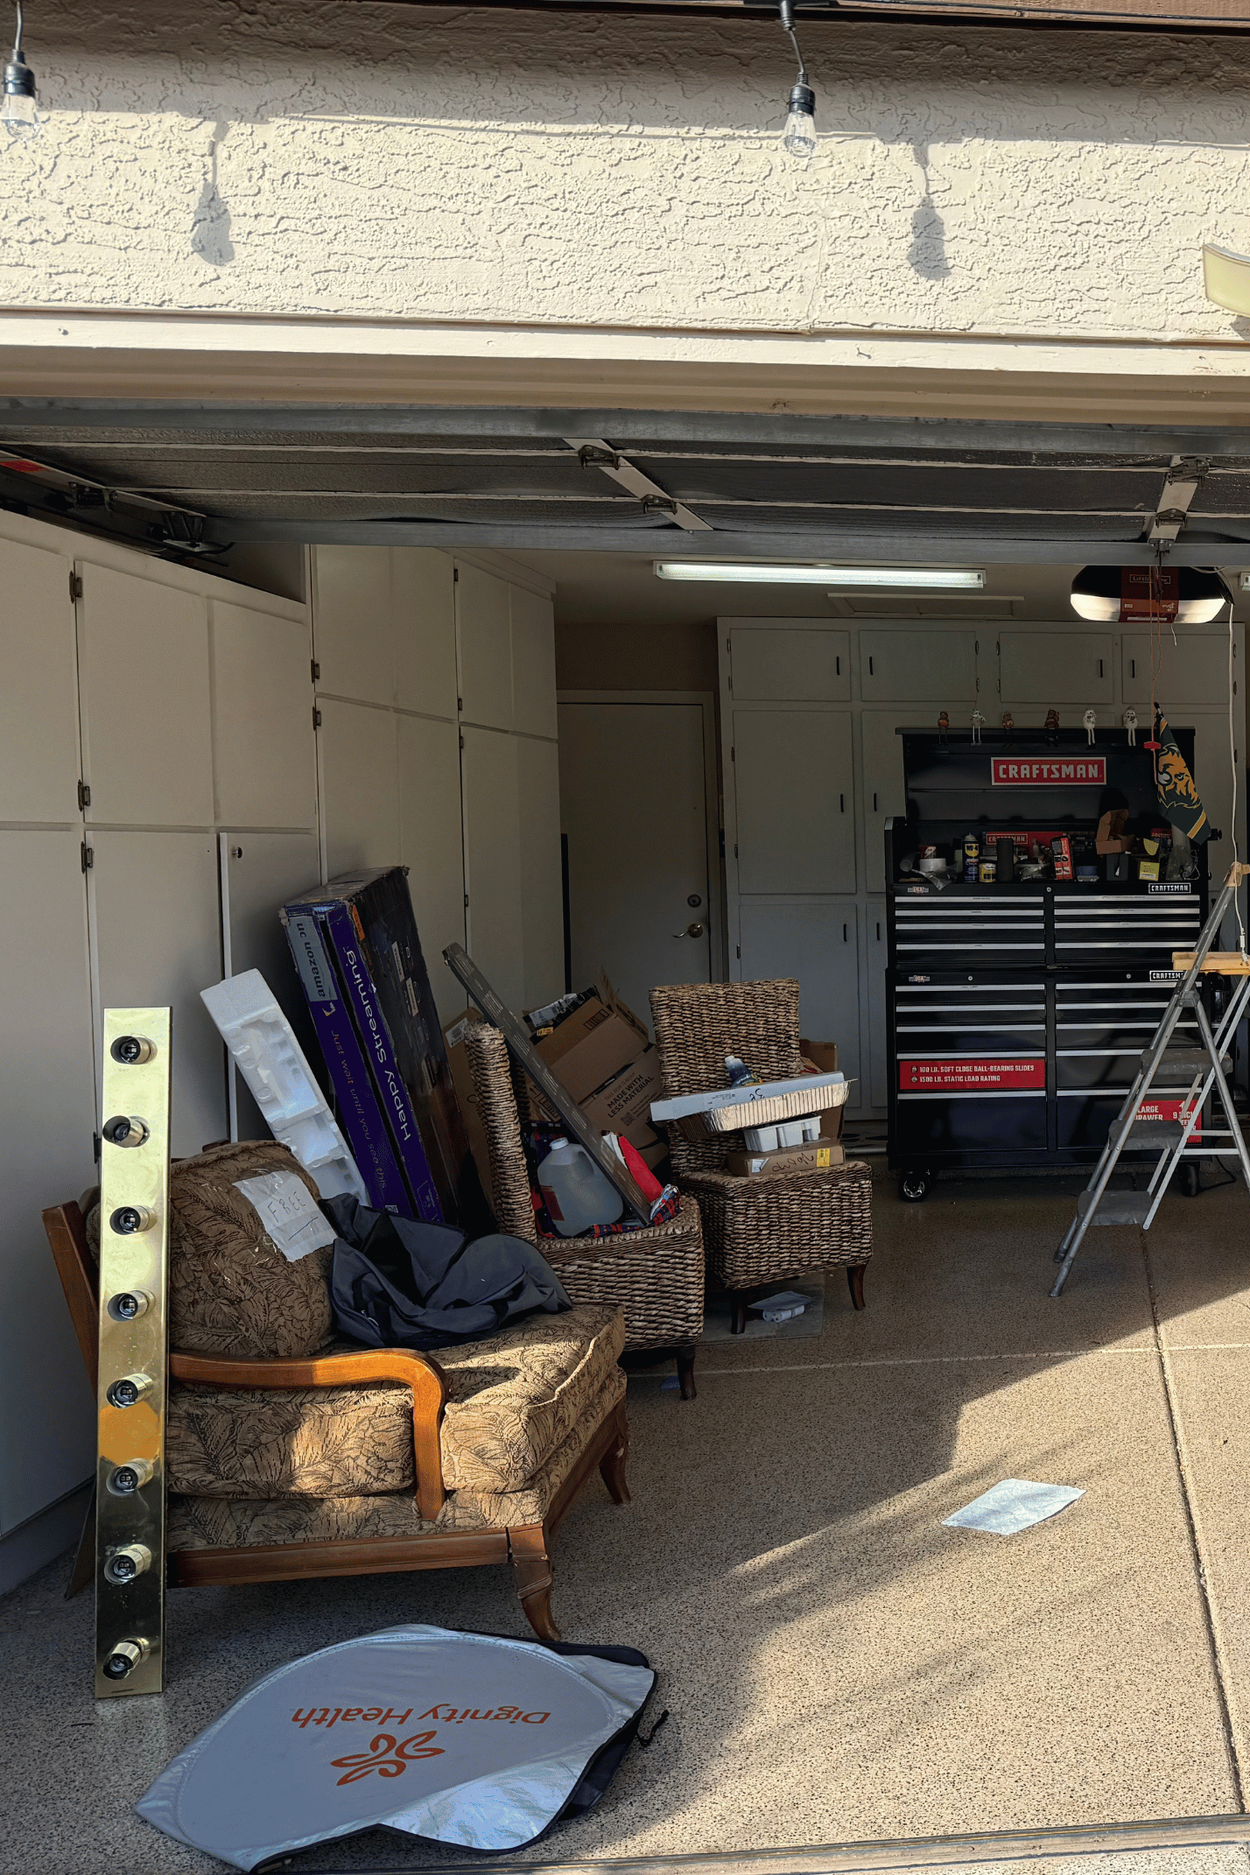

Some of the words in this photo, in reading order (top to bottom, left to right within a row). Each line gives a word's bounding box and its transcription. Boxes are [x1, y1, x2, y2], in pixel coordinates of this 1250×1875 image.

[998, 764, 1099, 779] CRAFTSMAN
[1151, 884, 1189, 892] CRAFTSMAN
[303, 942, 326, 998] amazon
[346, 949, 388, 1064] Streaming
[955, 1065, 973, 1073] CLOSE
[973, 1065, 1015, 1073] BALL-BEARING
[1014, 1064, 1035, 1072] SLIDES
[384, 1070, 412, 1141] Happy
[606, 1090, 627, 1109] MADE
[625, 1074, 644, 1094] WITH
[607, 1102, 625, 1119] LESS
[623, 1076, 655, 1105] MATERIAL
[341, 1059, 355, 1085] wait
[350, 1088, 366, 1115] until
[358, 1117, 372, 1141] you
[368, 1143, 380, 1165] see
[267, 1191, 306, 1223] FREE
[291, 1706, 414, 1729] Health
[417, 1703, 552, 1725] Dignity
